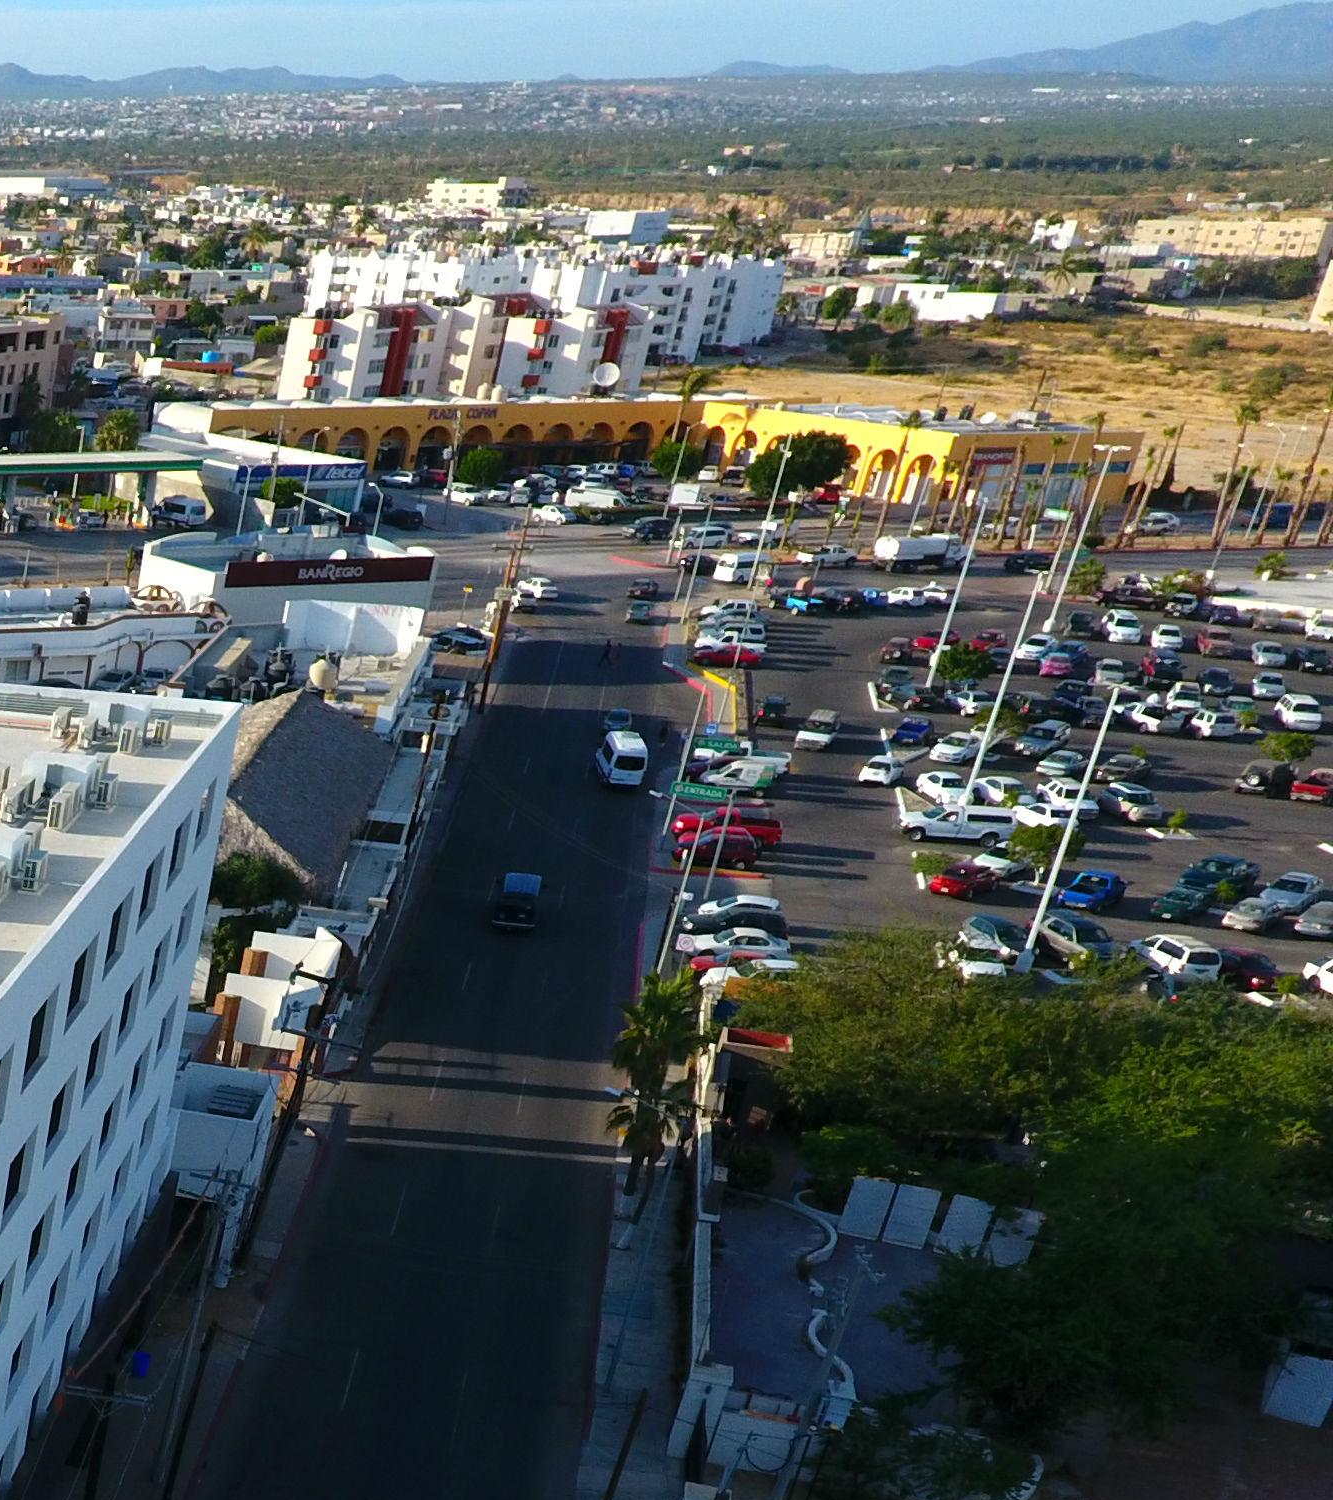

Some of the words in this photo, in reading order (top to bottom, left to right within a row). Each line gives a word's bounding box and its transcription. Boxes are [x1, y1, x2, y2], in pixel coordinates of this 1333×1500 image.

[428, 408, 459, 420] PLAZA
[325, 465, 363, 480] telcel
[298, 564, 364, 580] BANREGIO
[683, 786, 723, 798] ENTRADA
